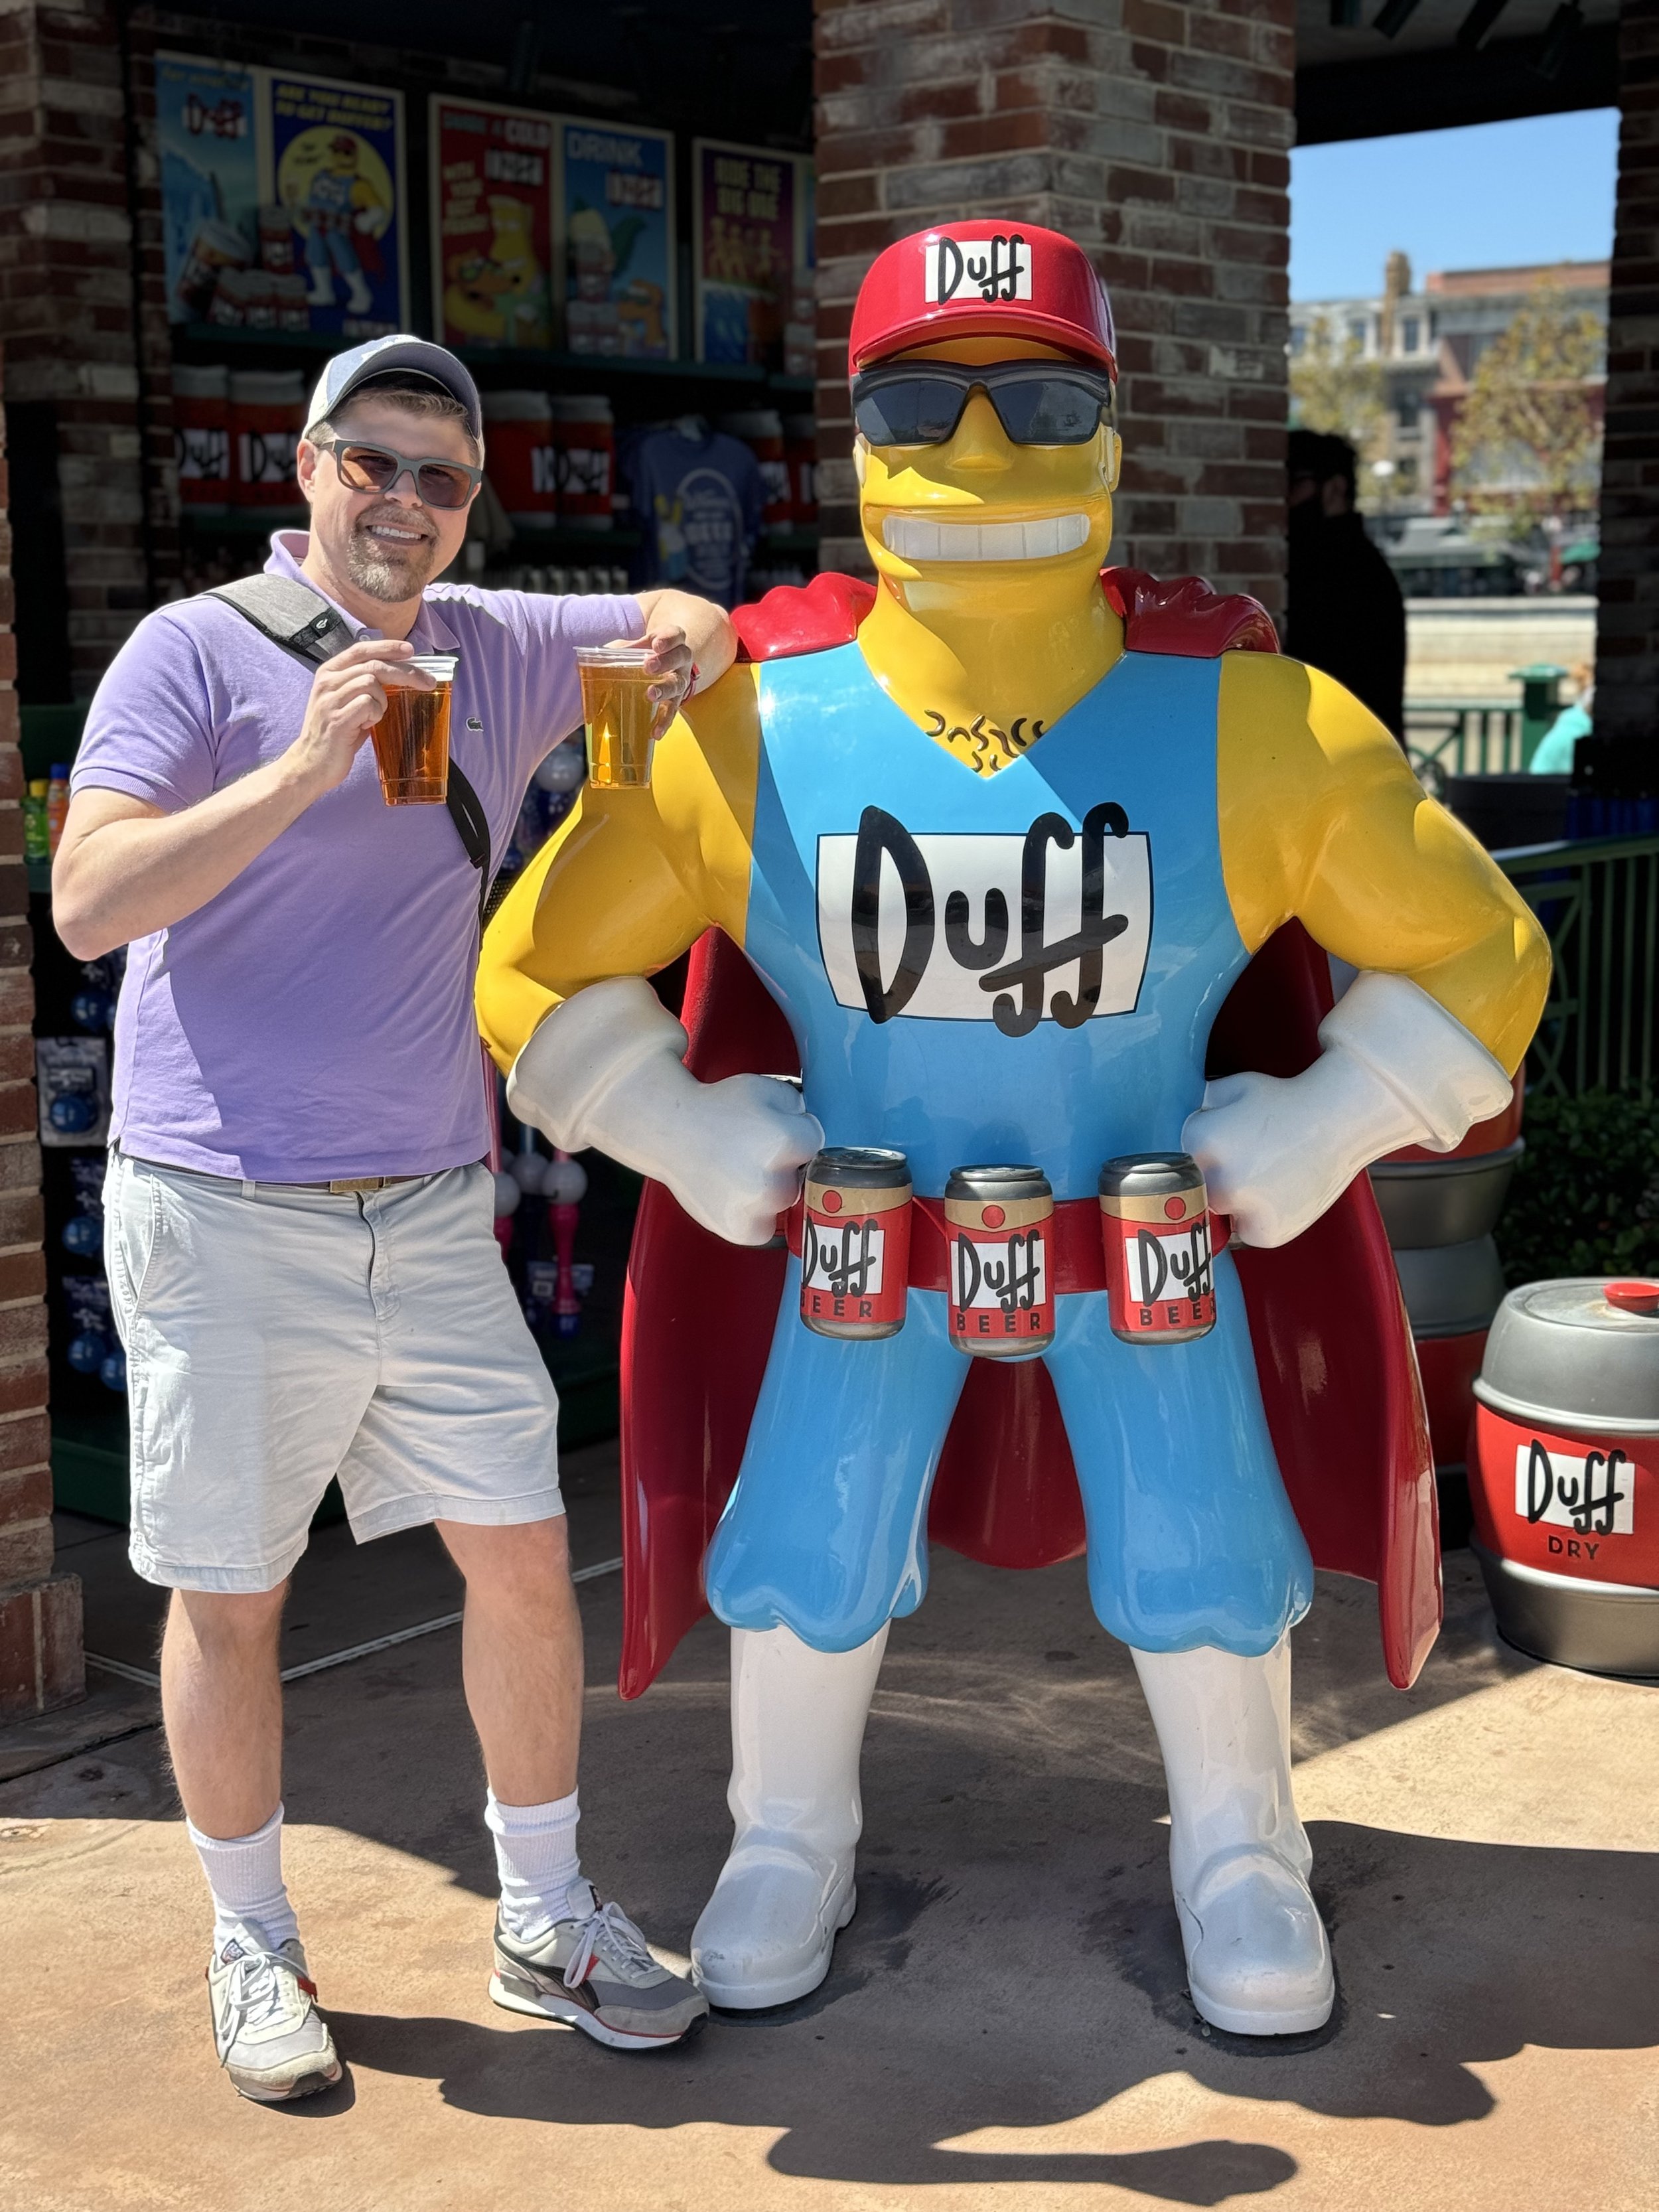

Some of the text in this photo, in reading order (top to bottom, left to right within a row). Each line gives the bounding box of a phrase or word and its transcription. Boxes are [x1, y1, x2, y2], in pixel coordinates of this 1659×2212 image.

[568, 130, 643, 168] DRINK
[938, 234, 1025, 305] Duff
[851, 802, 1129, 1037] Duff
[801, 1212, 879, 1298] Duff
[958, 1229, 1041, 1313] Duff
[1138, 1217, 1211, 1307] Duff
[957, 1313, 1040, 1333] BEER
[1528, 1438, 1626, 1535] Duff
[1548, 1534, 1599, 1560] DRY
